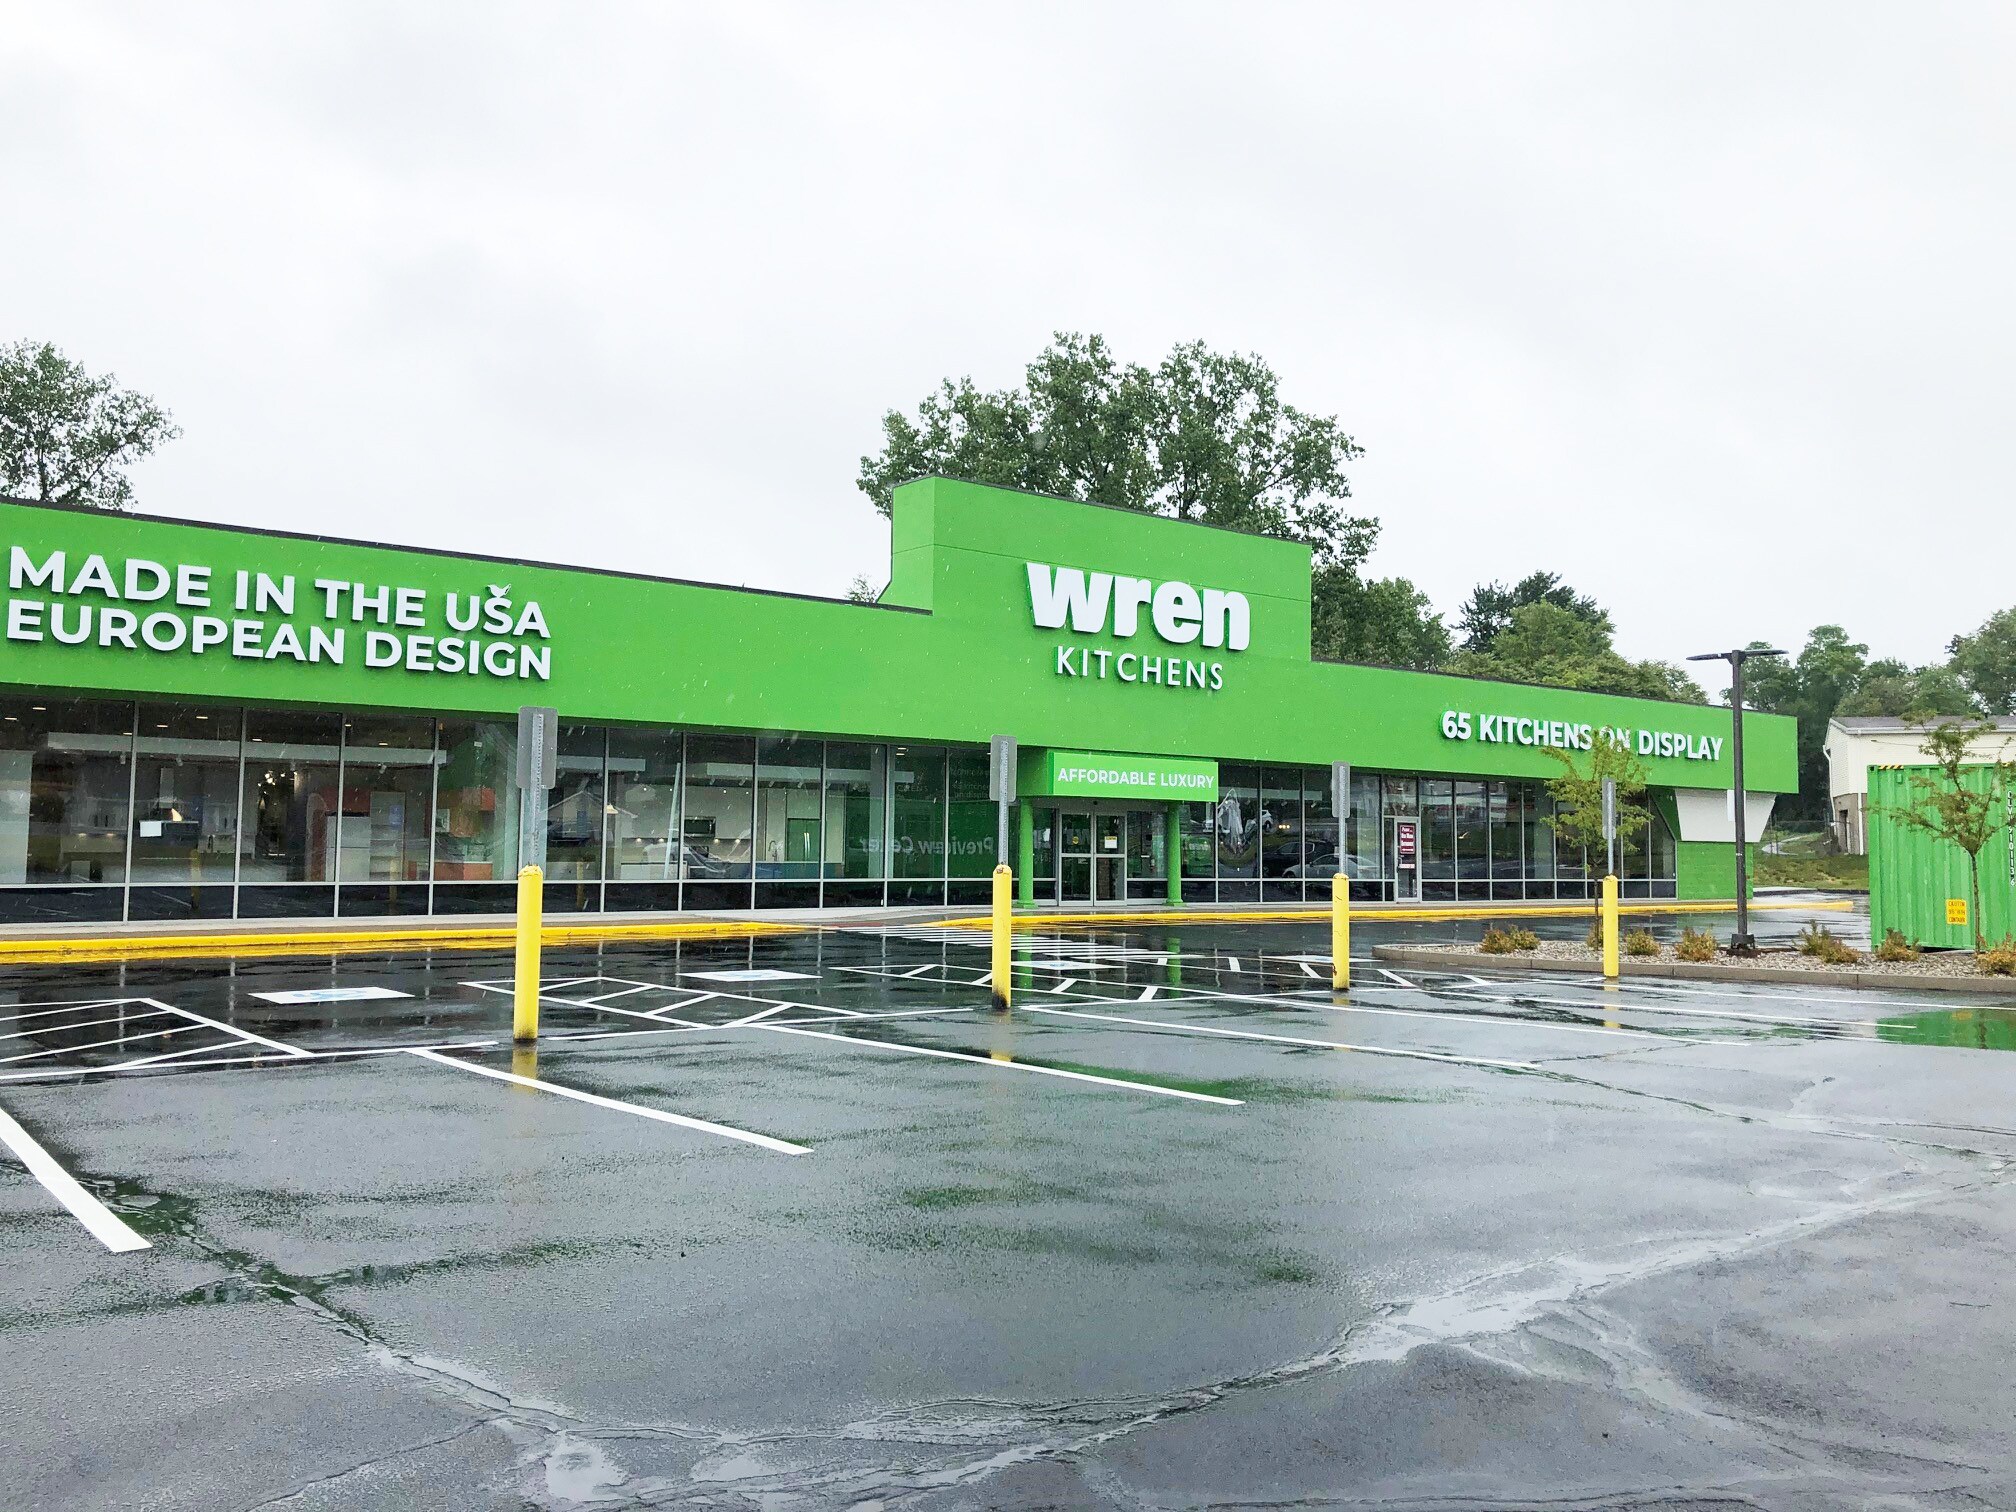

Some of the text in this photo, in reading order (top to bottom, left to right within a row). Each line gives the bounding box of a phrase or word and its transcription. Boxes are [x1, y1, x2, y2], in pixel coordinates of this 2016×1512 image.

[9, 546, 551, 639] MADE IN THE USA
[1025, 562, 1250, 651] wren
[7, 599, 551, 680] EUROPEAN DESIGN
[1056, 645, 1223, 690] KITCHENS
[1441, 710, 1472, 740] 65
[1478, 713, 1592, 750] KITCHENS
[1637, 729, 1724, 761] DISPLAY
[1057, 768, 1214, 789] AFFORDABLE LUXURY
